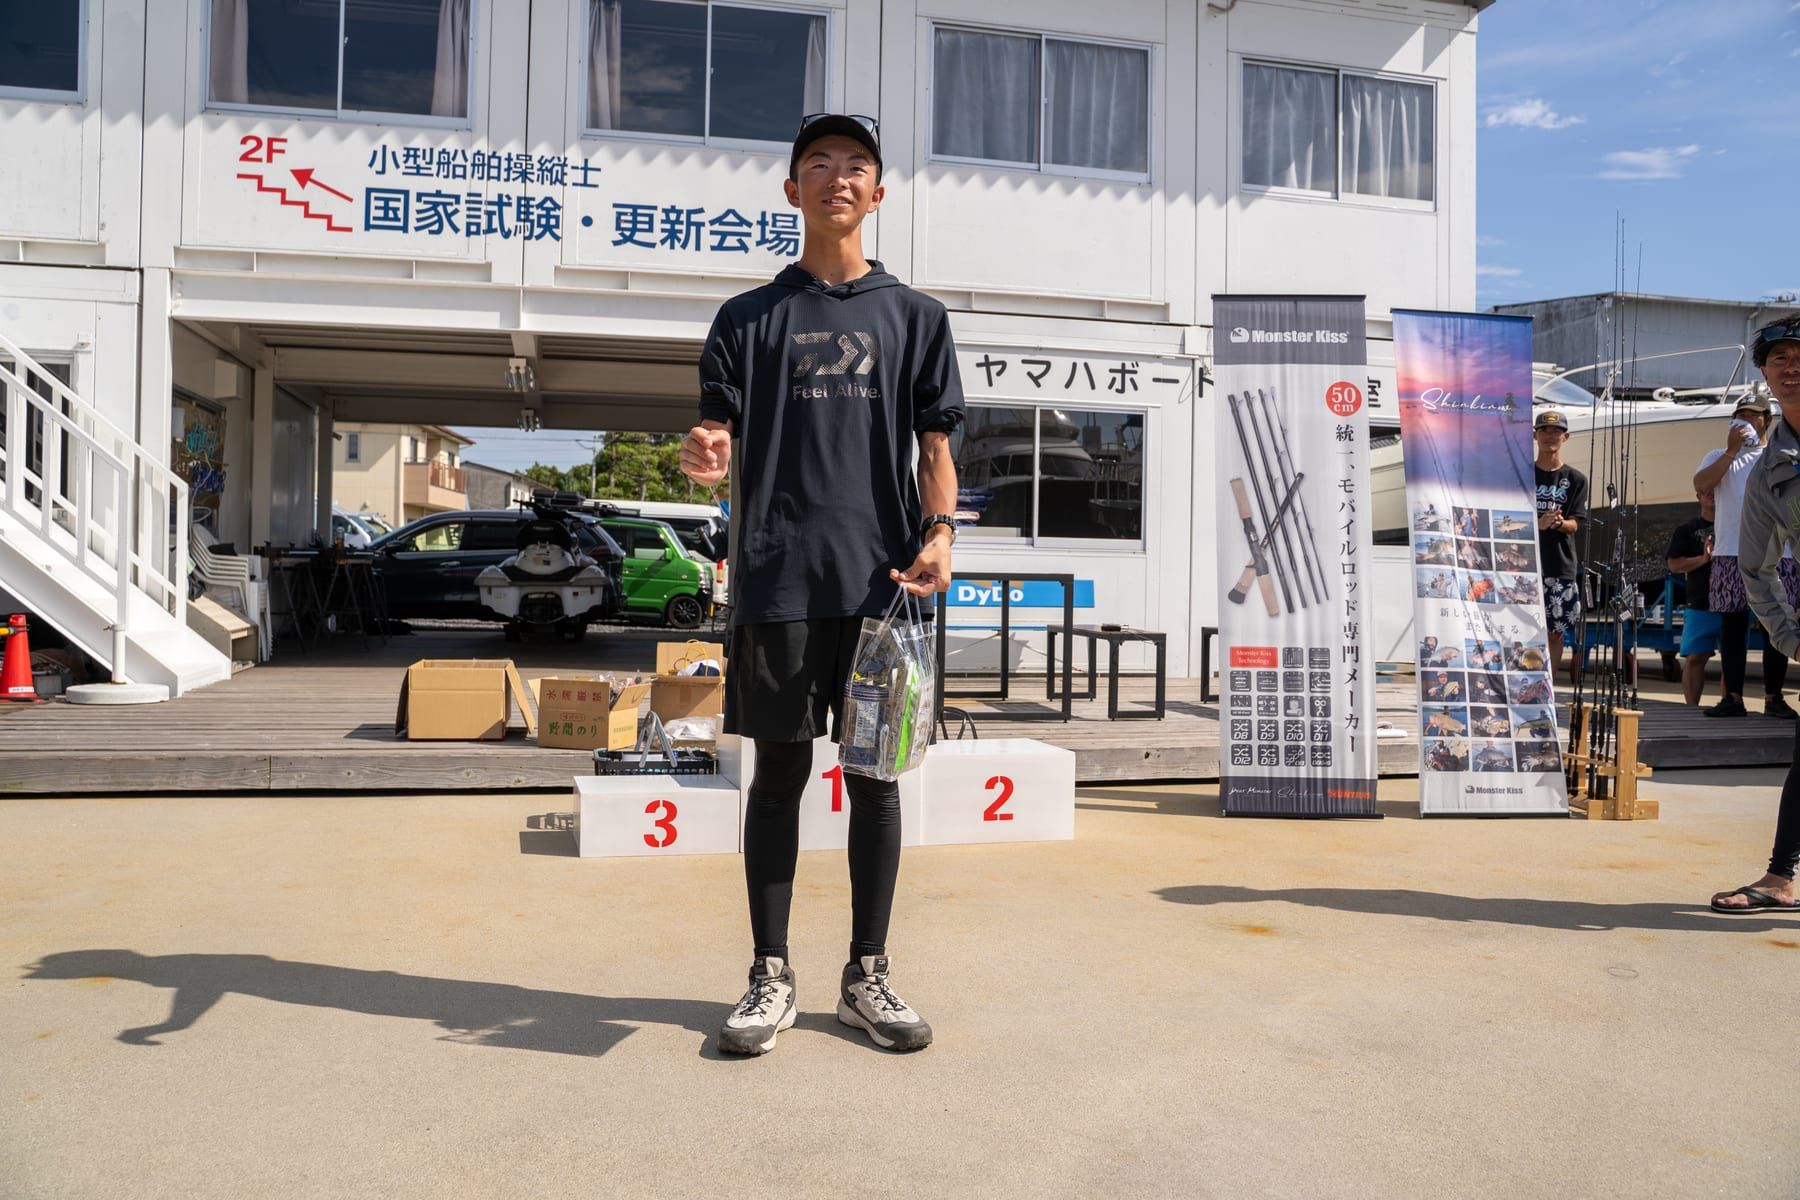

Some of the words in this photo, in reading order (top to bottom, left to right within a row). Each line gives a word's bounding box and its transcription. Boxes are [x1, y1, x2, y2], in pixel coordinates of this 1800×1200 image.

[239, 136, 288, 164] 2F
[367, 144, 601, 189] 小型船舶操縦士
[363, 186, 801, 257] 国家試験・更新会場
[1251, 329, 1314, 344] Monster
[1315, 329, 1349, 344] Kiss
[792, 384, 829, 400] Feel
[1331, 386, 1357, 404] 50
[1333, 402, 1354, 413] cm
[1236, 649, 1259, 657] Monster
[1238, 657, 1270, 665] Technology
[1234, 731, 1249, 740] D8
[1260, 732, 1275, 740] D9
[821, 764, 843, 813] 1
[1475, 786, 1506, 795] Monster
[1506, 786, 1524, 795] Kiss
[983, 775, 1014, 822] 2
[643, 799, 678, 848] 3
